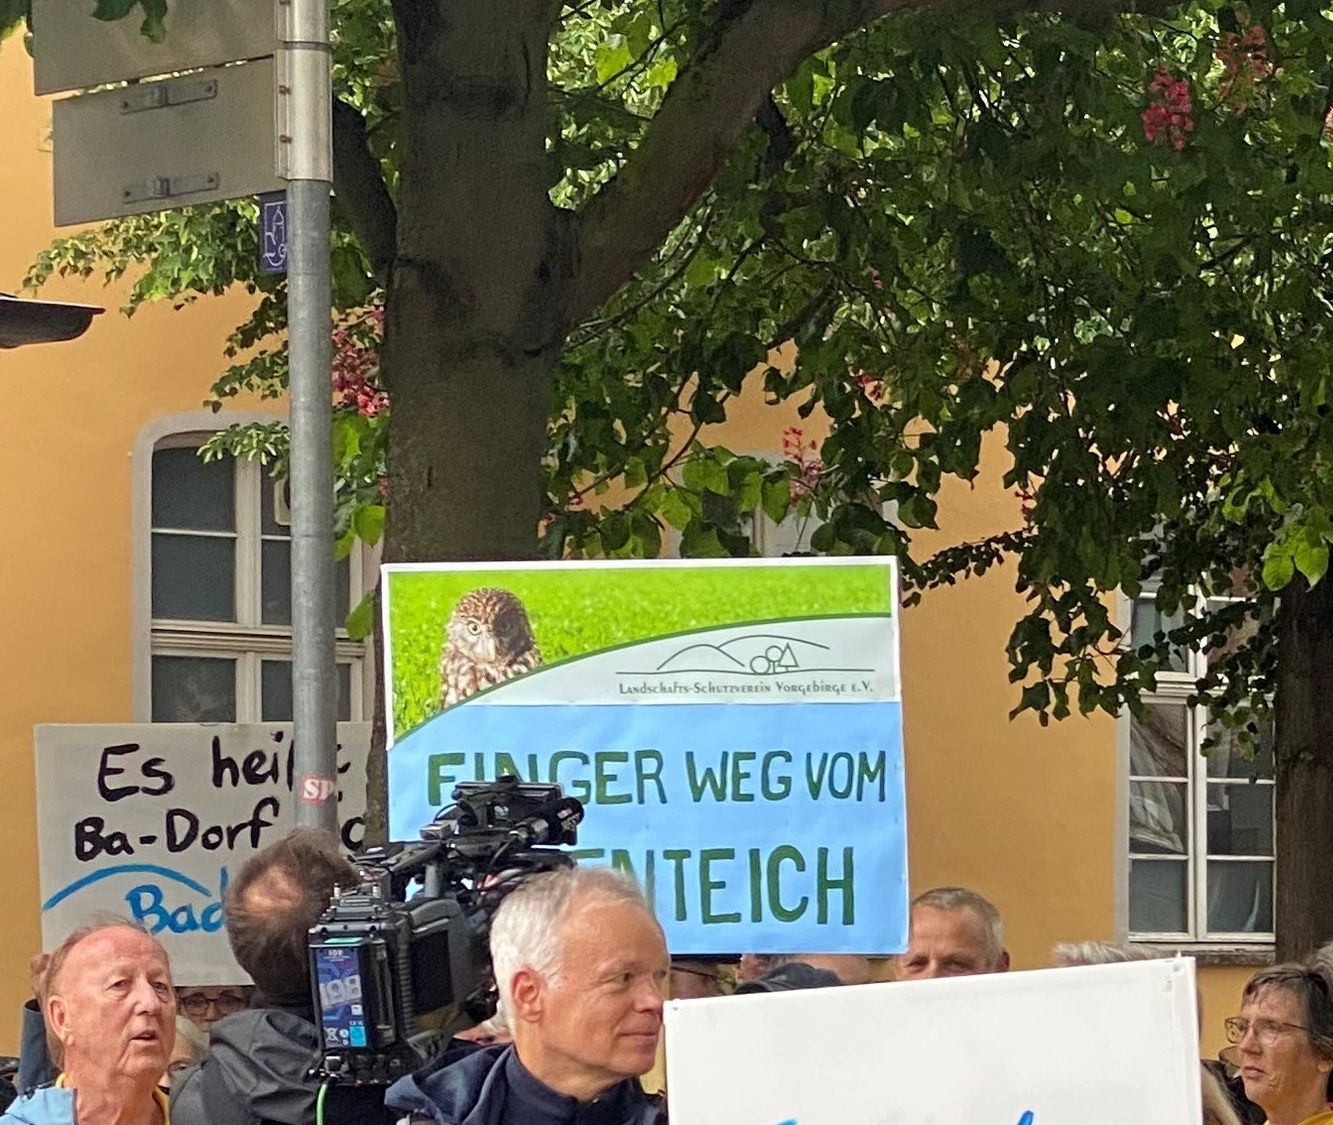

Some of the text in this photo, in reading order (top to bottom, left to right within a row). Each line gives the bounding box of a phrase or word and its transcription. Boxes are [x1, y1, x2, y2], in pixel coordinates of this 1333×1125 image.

[97, 743, 175, 802] Es
[427, 749, 887, 806] FINGER WEG VOM
[75, 797, 279, 861] Ba-Dorf
